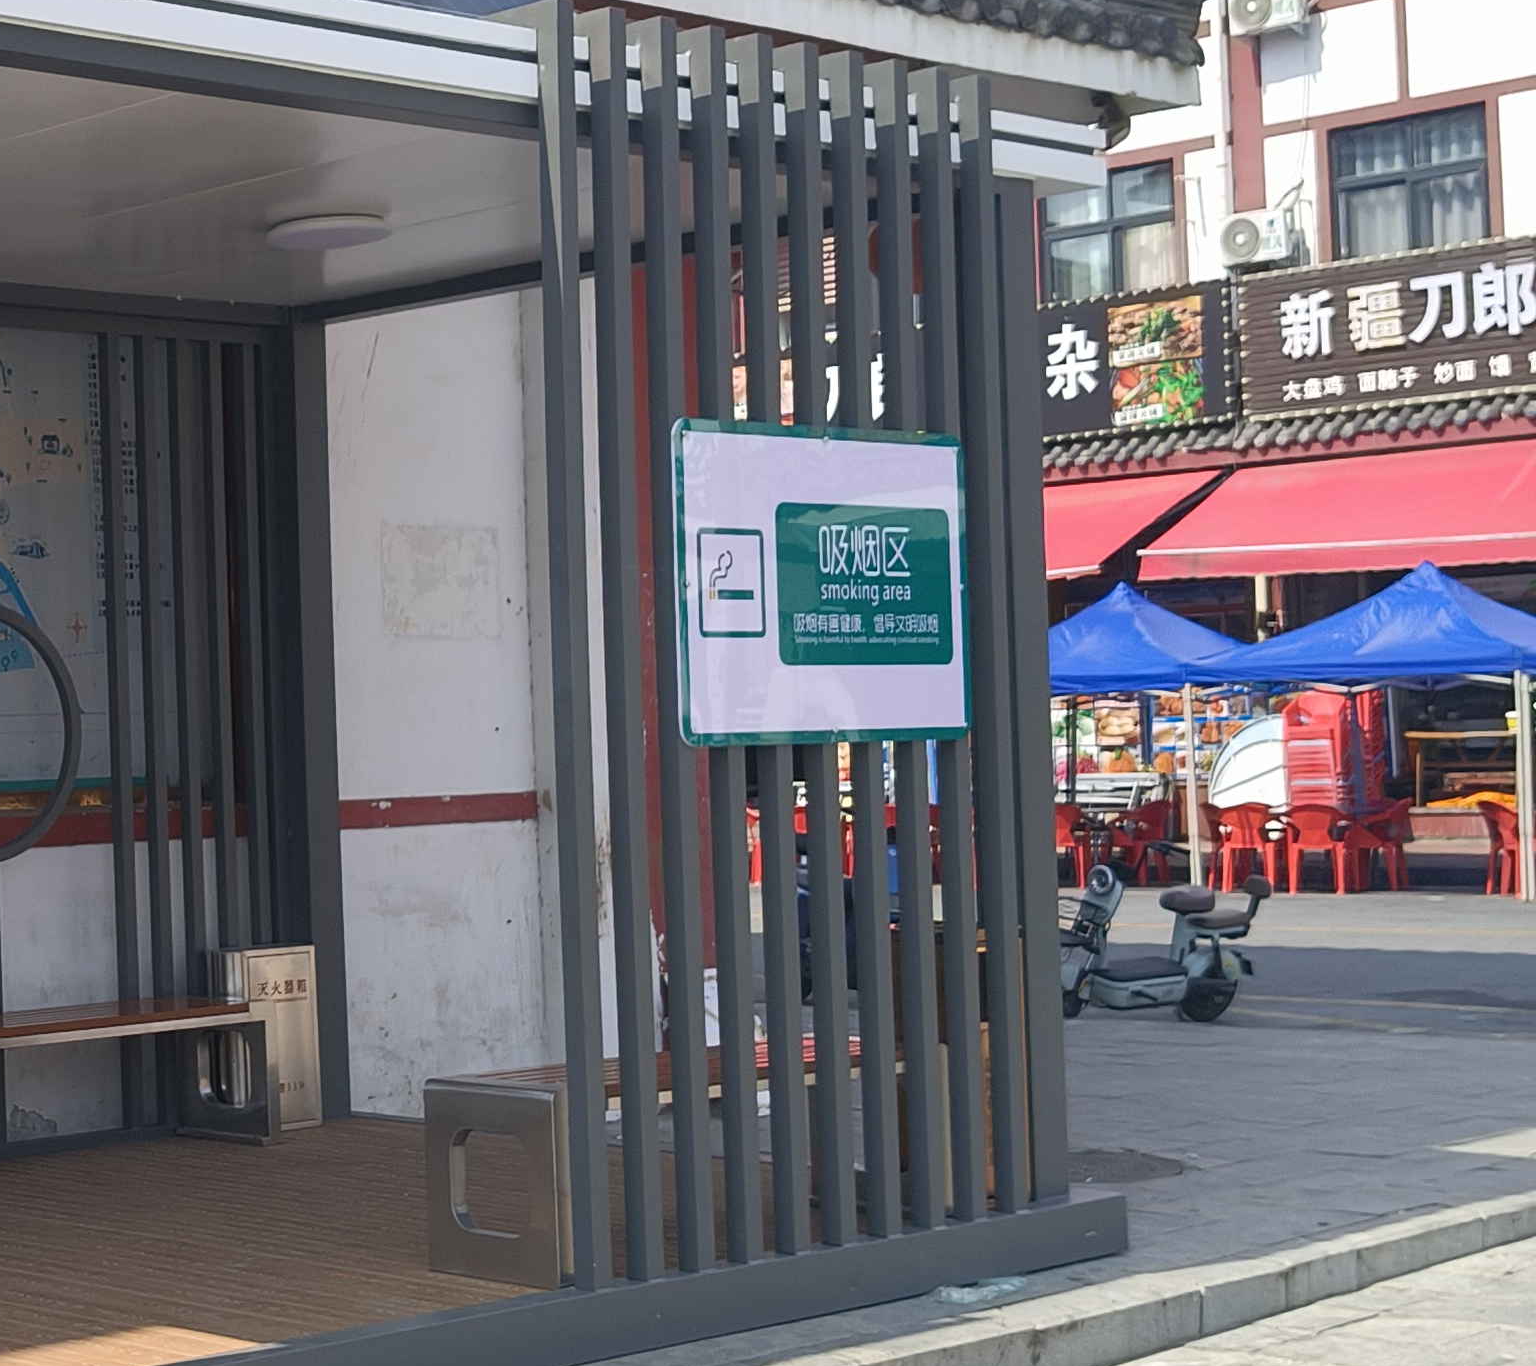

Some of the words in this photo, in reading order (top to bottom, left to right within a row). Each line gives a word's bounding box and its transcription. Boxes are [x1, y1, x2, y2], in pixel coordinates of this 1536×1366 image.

[1280, 262, 1535, 361] 新疆刀郎
[1045, 323, 1100, 401] 杂
[1433, 359, 1478, 384] 炒面
[818, 523, 911, 578] 吸烟区
[820, 578, 879, 607] smoking
[882, 584, 911, 601] area
[257, 979, 307, 997] 灭火器箱
